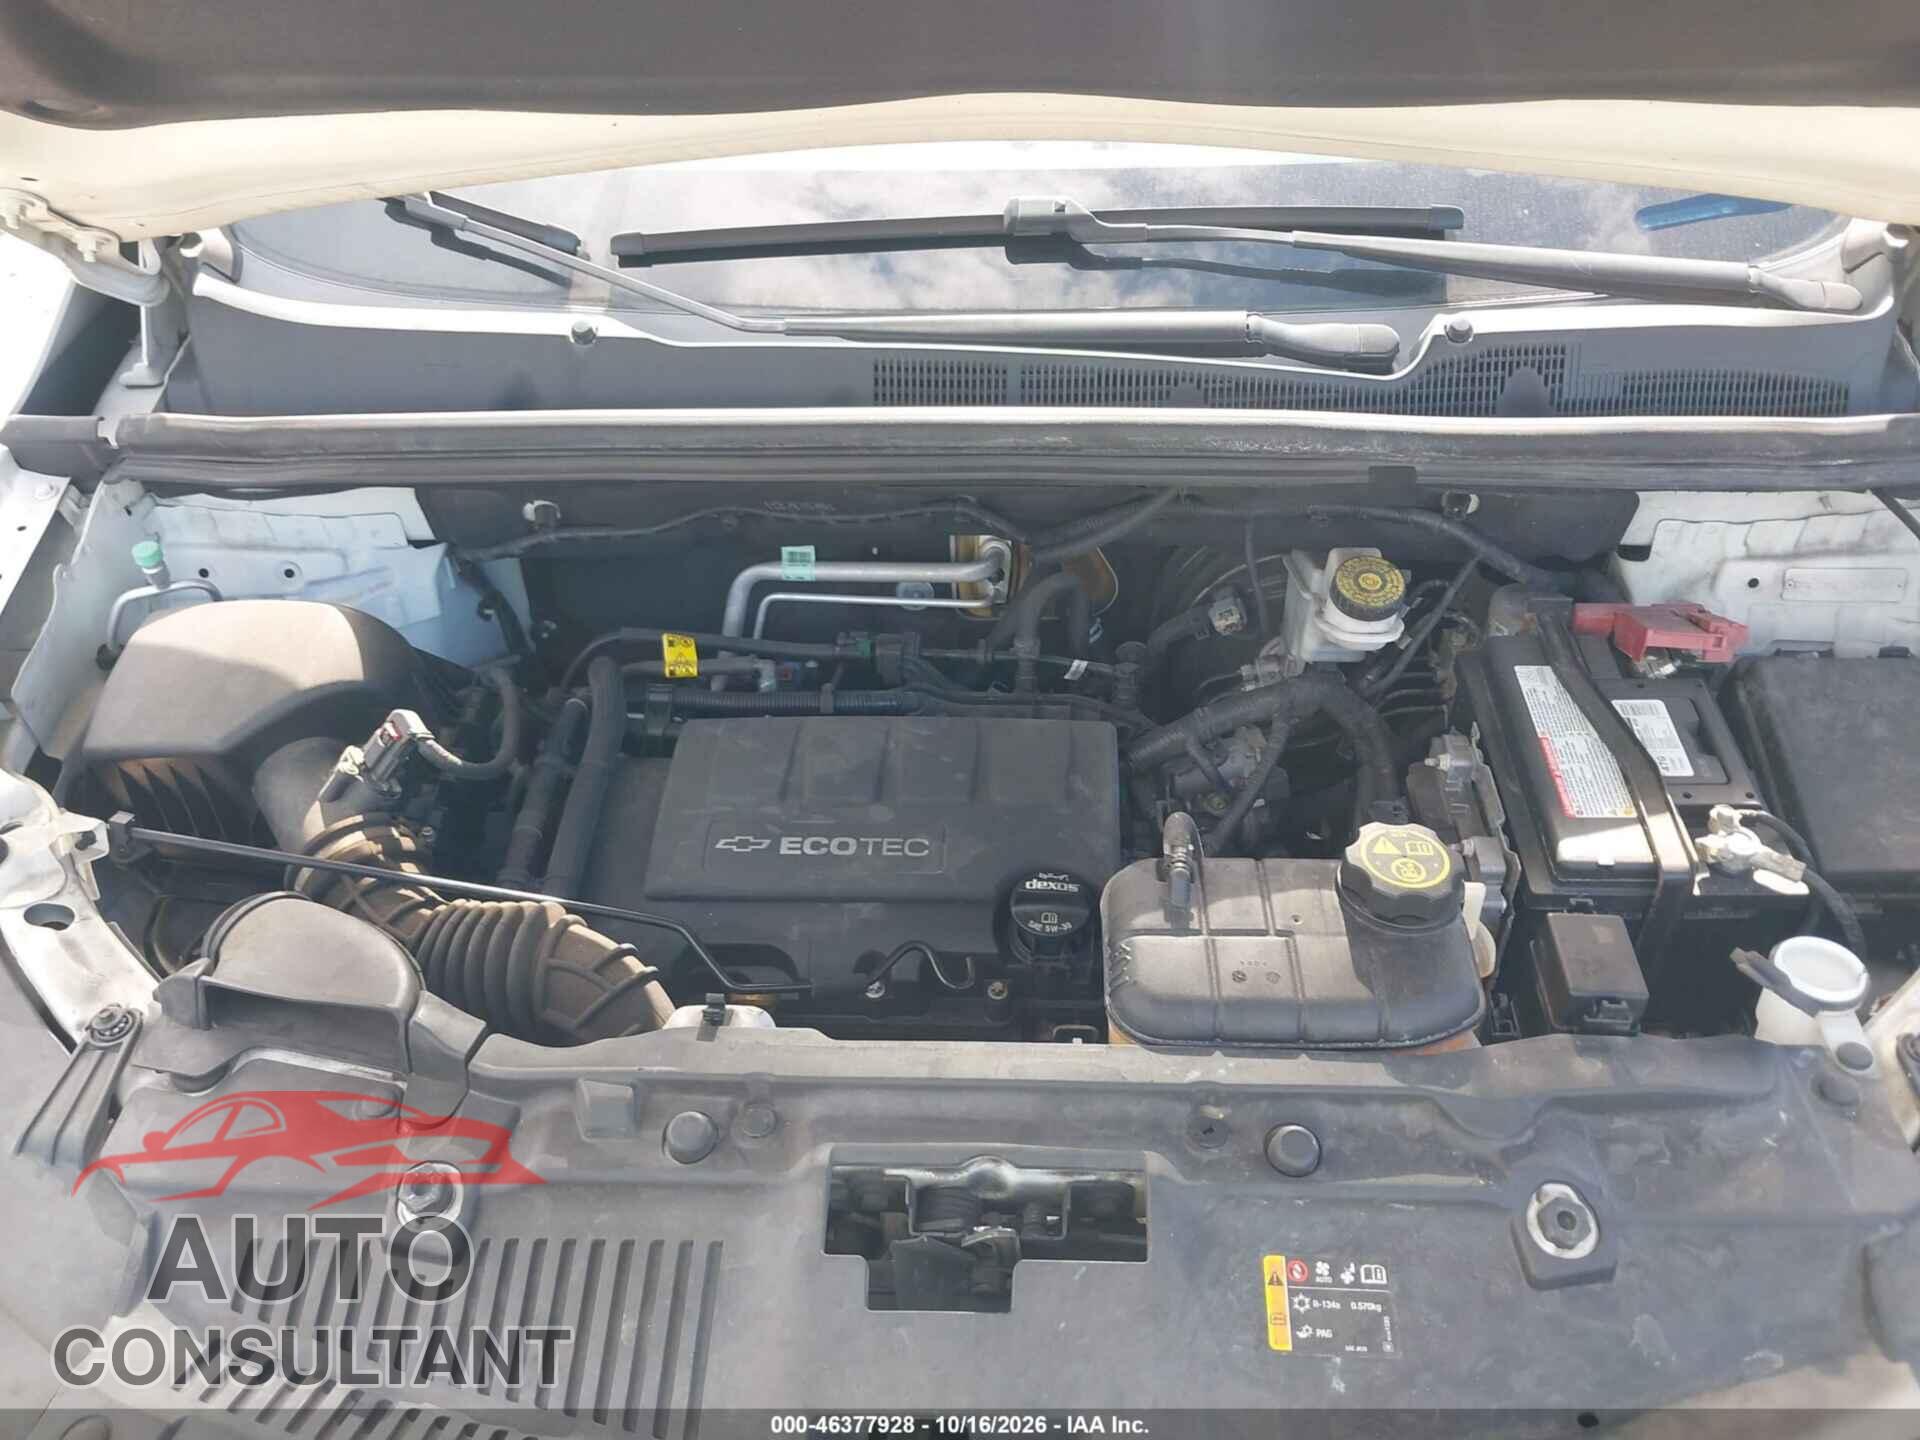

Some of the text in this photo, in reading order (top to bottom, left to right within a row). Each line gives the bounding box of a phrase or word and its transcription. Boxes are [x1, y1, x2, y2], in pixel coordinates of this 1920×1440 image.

[779, 836, 930, 857] ECOTEC
[1025, 878, 1081, 892] dexos
[1315, 1328, 1333, 1338] PAG
